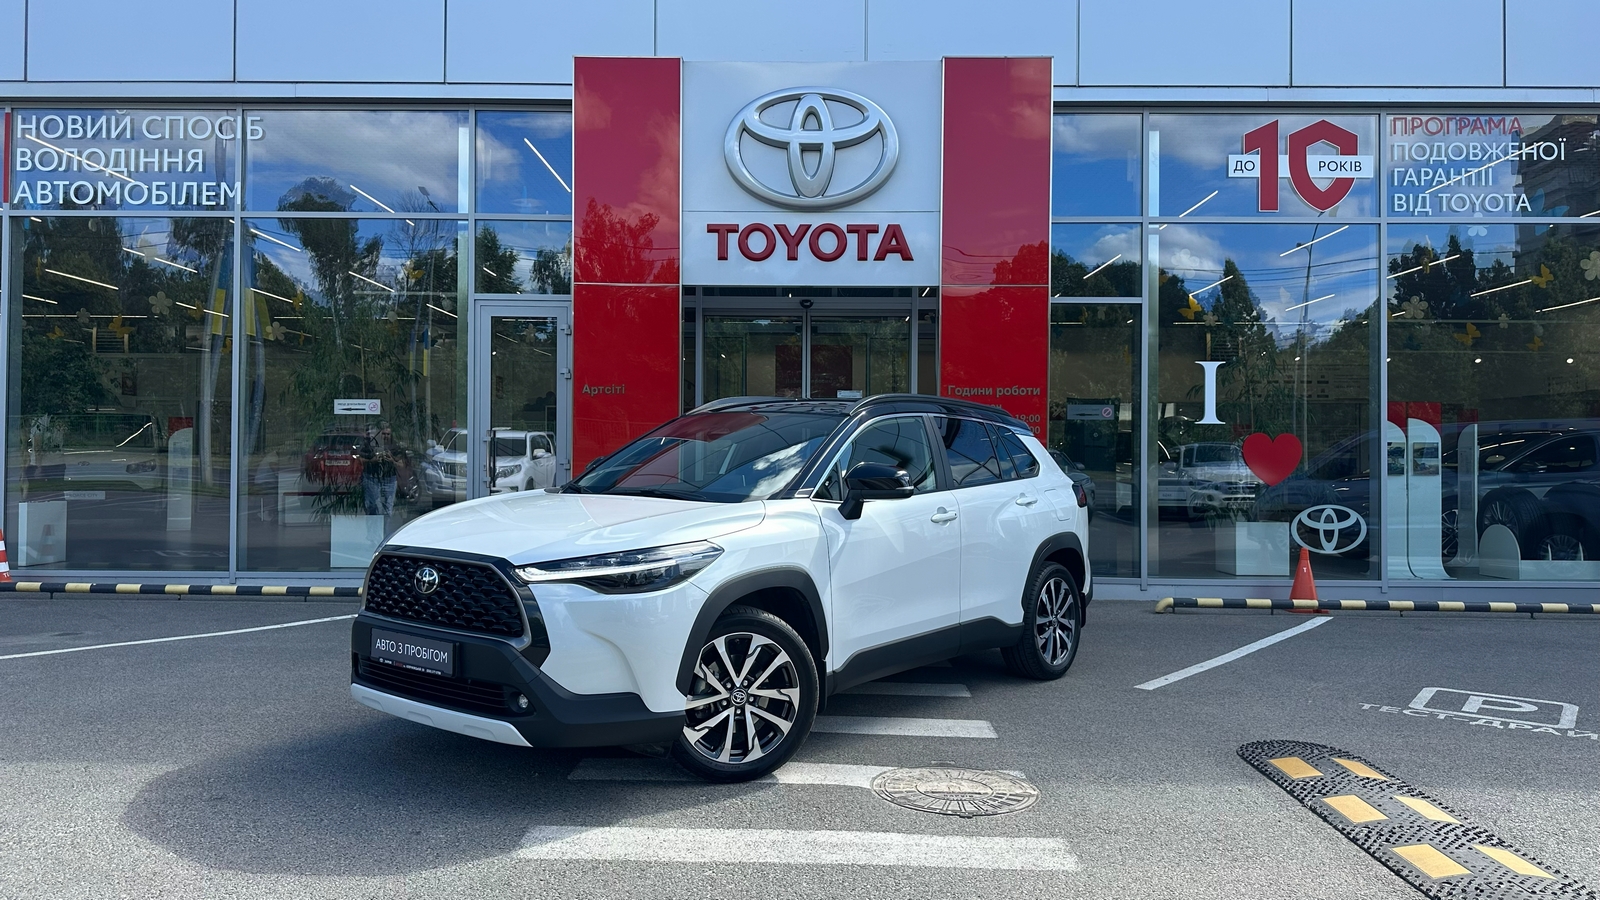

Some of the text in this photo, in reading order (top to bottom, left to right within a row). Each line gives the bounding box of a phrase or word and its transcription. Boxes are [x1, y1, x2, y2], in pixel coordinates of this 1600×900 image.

[17, 109, 264, 140] НОВИЙ СПОСІБ
[1392, 116, 1524, 135] ПРОГРАМА
[16, 148, 204, 177] ВОЛОДІННЯ
[1393, 137, 1567, 165] ПОДОВЖЕНОЇ
[1233, 159, 1256, 174] ДО
[1318, 160, 1363, 173] РОКІВ
[1393, 162, 1494, 187] ГАРАНТІЇ
[13, 181, 242, 206] АВТОМОБІЛЕМ
[1393, 193, 1533, 216] ВІД TOYOTA
[706, 222, 915, 262] TOYOTA
[582, 383, 626, 398] Артсіті
[947, 384, 1041, 399] Години роботи
[375, 638, 397, 653] АВТО
[404, 643, 449, 664] ПРОБІГОМ
[1461, 696, 1538, 713] P
